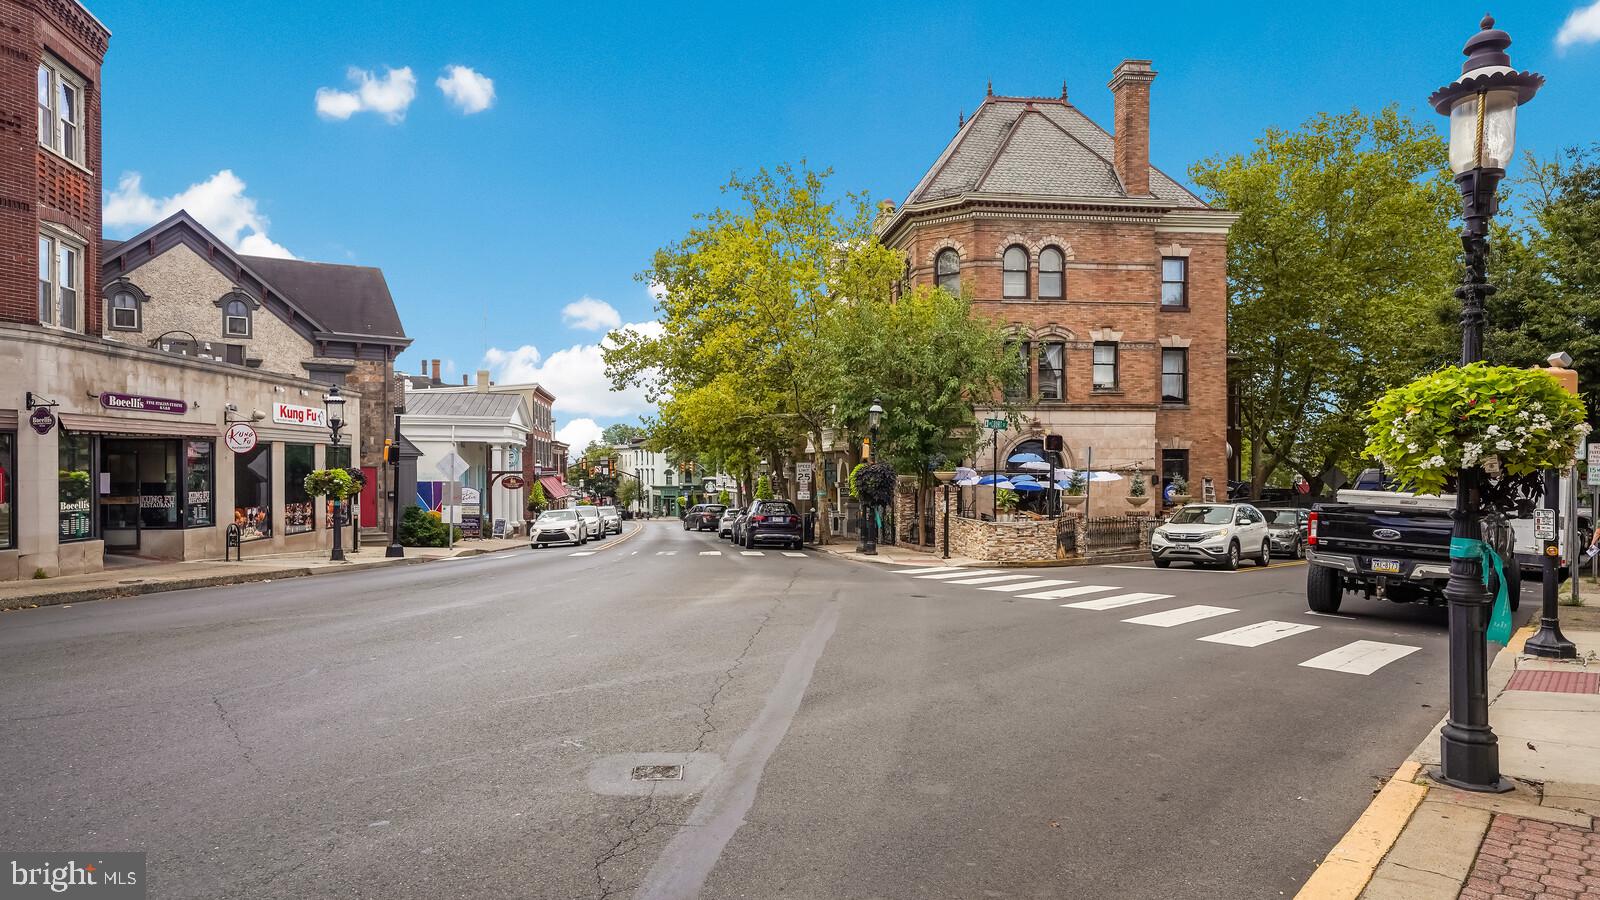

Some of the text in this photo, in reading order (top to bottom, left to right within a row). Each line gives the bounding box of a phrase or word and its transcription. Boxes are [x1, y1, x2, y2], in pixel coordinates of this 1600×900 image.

[280, 404, 317, 423] Kung Fu
[797, 473, 811, 481] 25
[140, 495, 176, 503] KUNG FU
